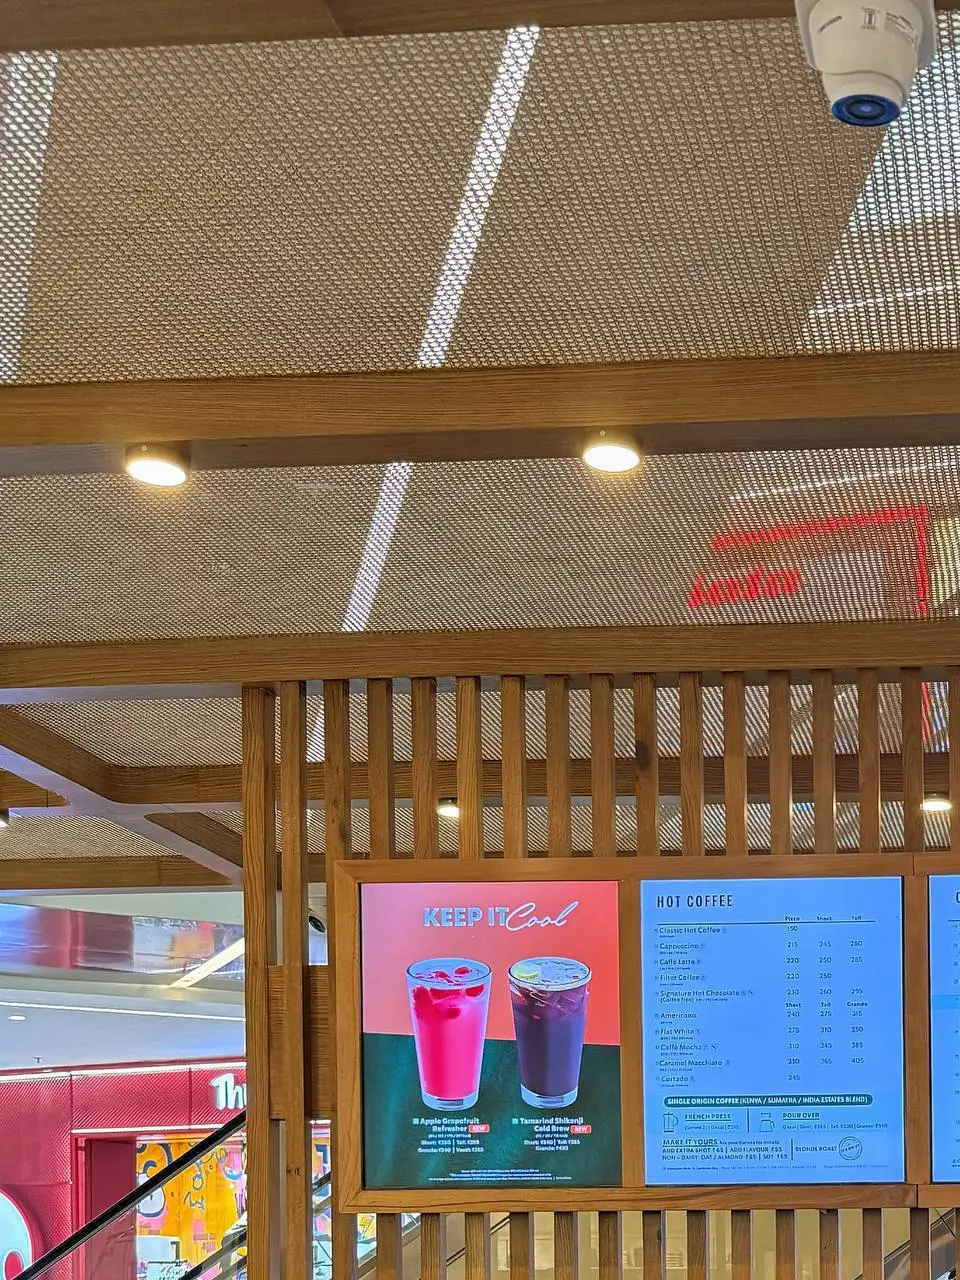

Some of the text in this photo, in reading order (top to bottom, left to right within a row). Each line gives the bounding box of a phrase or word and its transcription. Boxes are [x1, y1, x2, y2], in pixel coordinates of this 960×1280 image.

[657, 894, 733, 908] HOT COFFEE
[424, 901, 579, 931] KEEP IT Cool
[659, 943, 699, 951] Cappuccino
